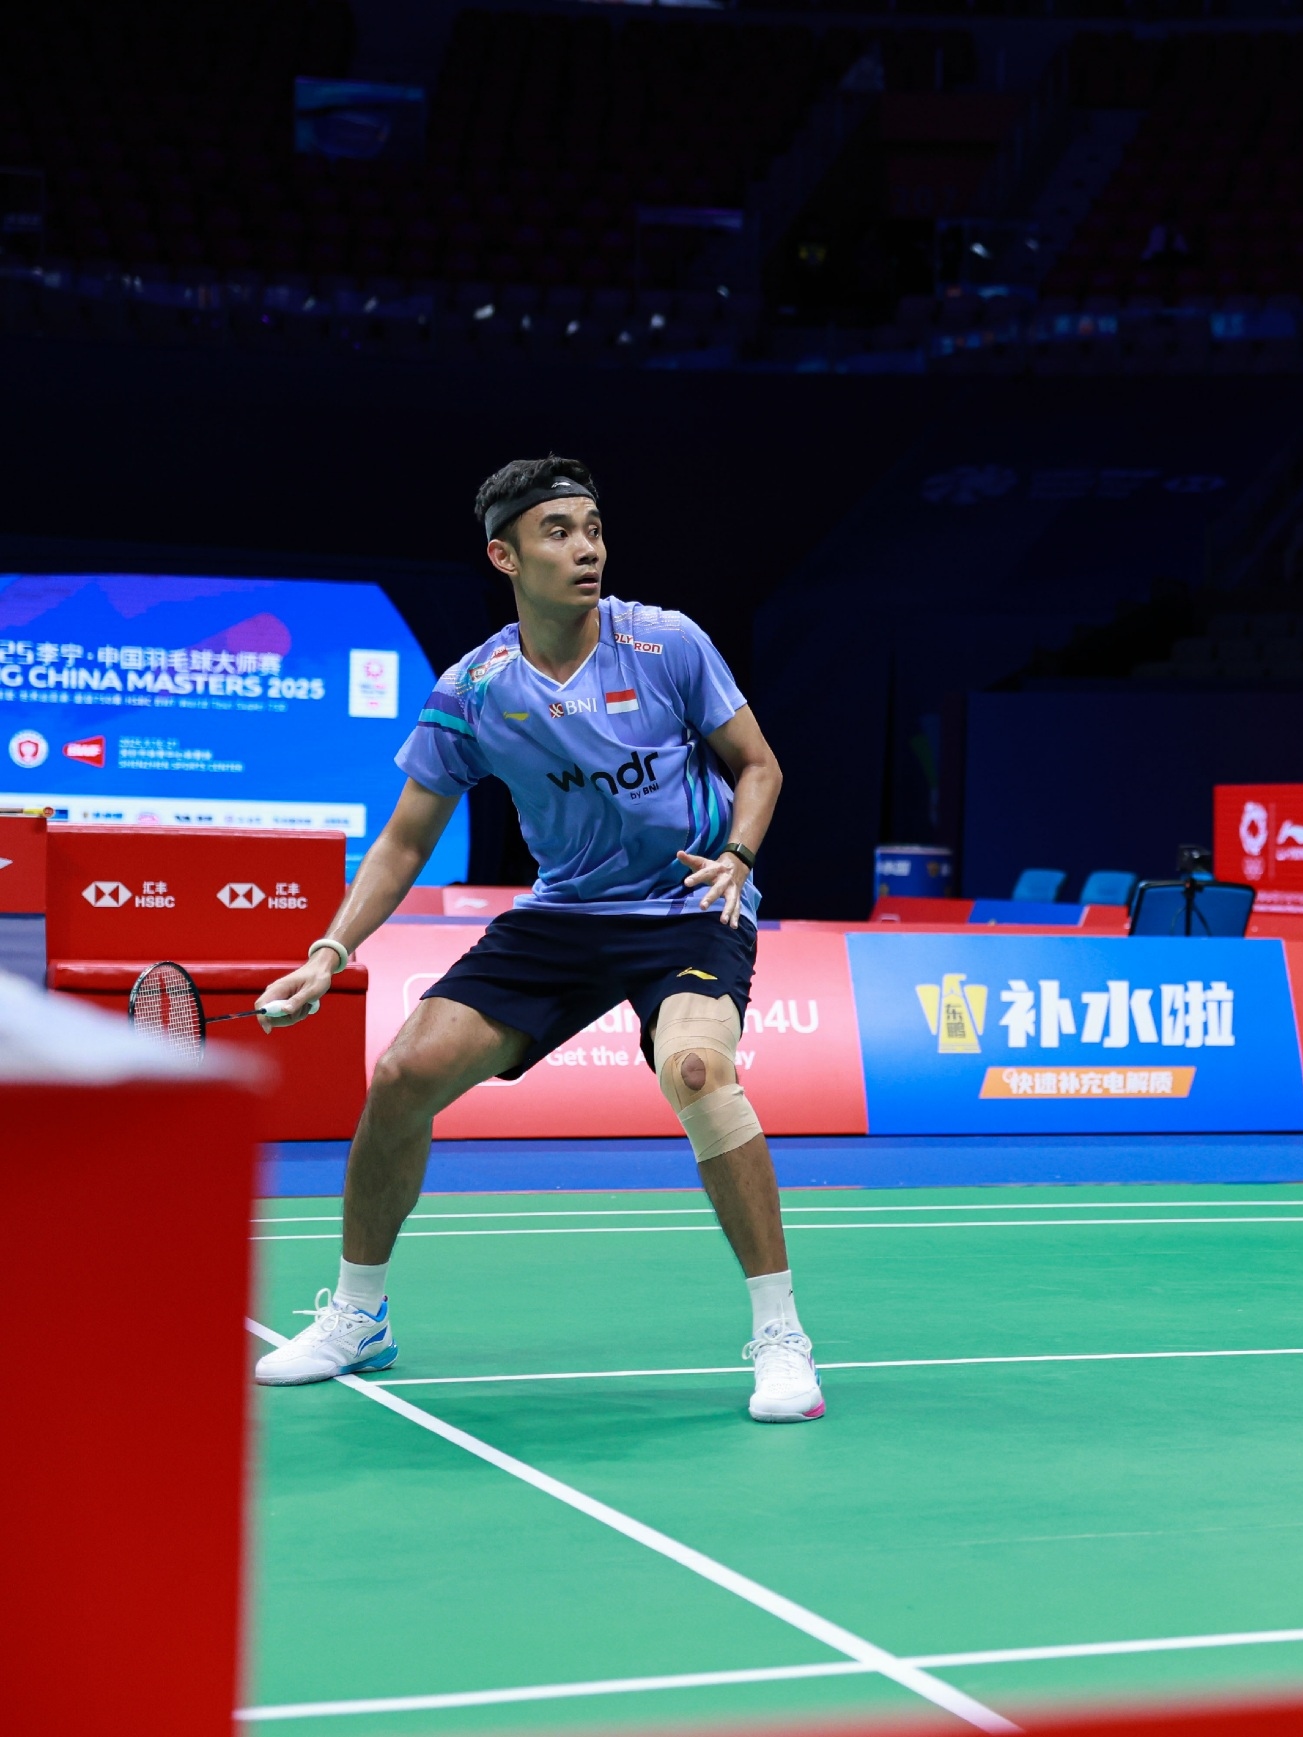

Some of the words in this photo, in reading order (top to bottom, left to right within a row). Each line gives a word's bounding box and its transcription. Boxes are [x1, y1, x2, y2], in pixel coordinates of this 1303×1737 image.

[29, 665, 122, 692] CHINA
[127, 670, 263, 698] MASTERS
[267, 677, 325, 700] 2025
[565, 698, 598, 716] BNI
[546, 751, 659, 795] wndr
[630, 792, 642, 800] by
[642, 784, 660, 796] BNI
[142, 881, 168, 894] 汇丰
[275, 882, 300, 895] 汇丰
[135, 896, 175, 908] HSBC
[268, 897, 307, 909] HSBC
[1000, 978, 1236, 1049] 补水啦
[547, 1046, 588, 1066] Get
[591, 1046, 630, 1066] the
[1009, 1070, 1174, 1095] 快速补充电解质
